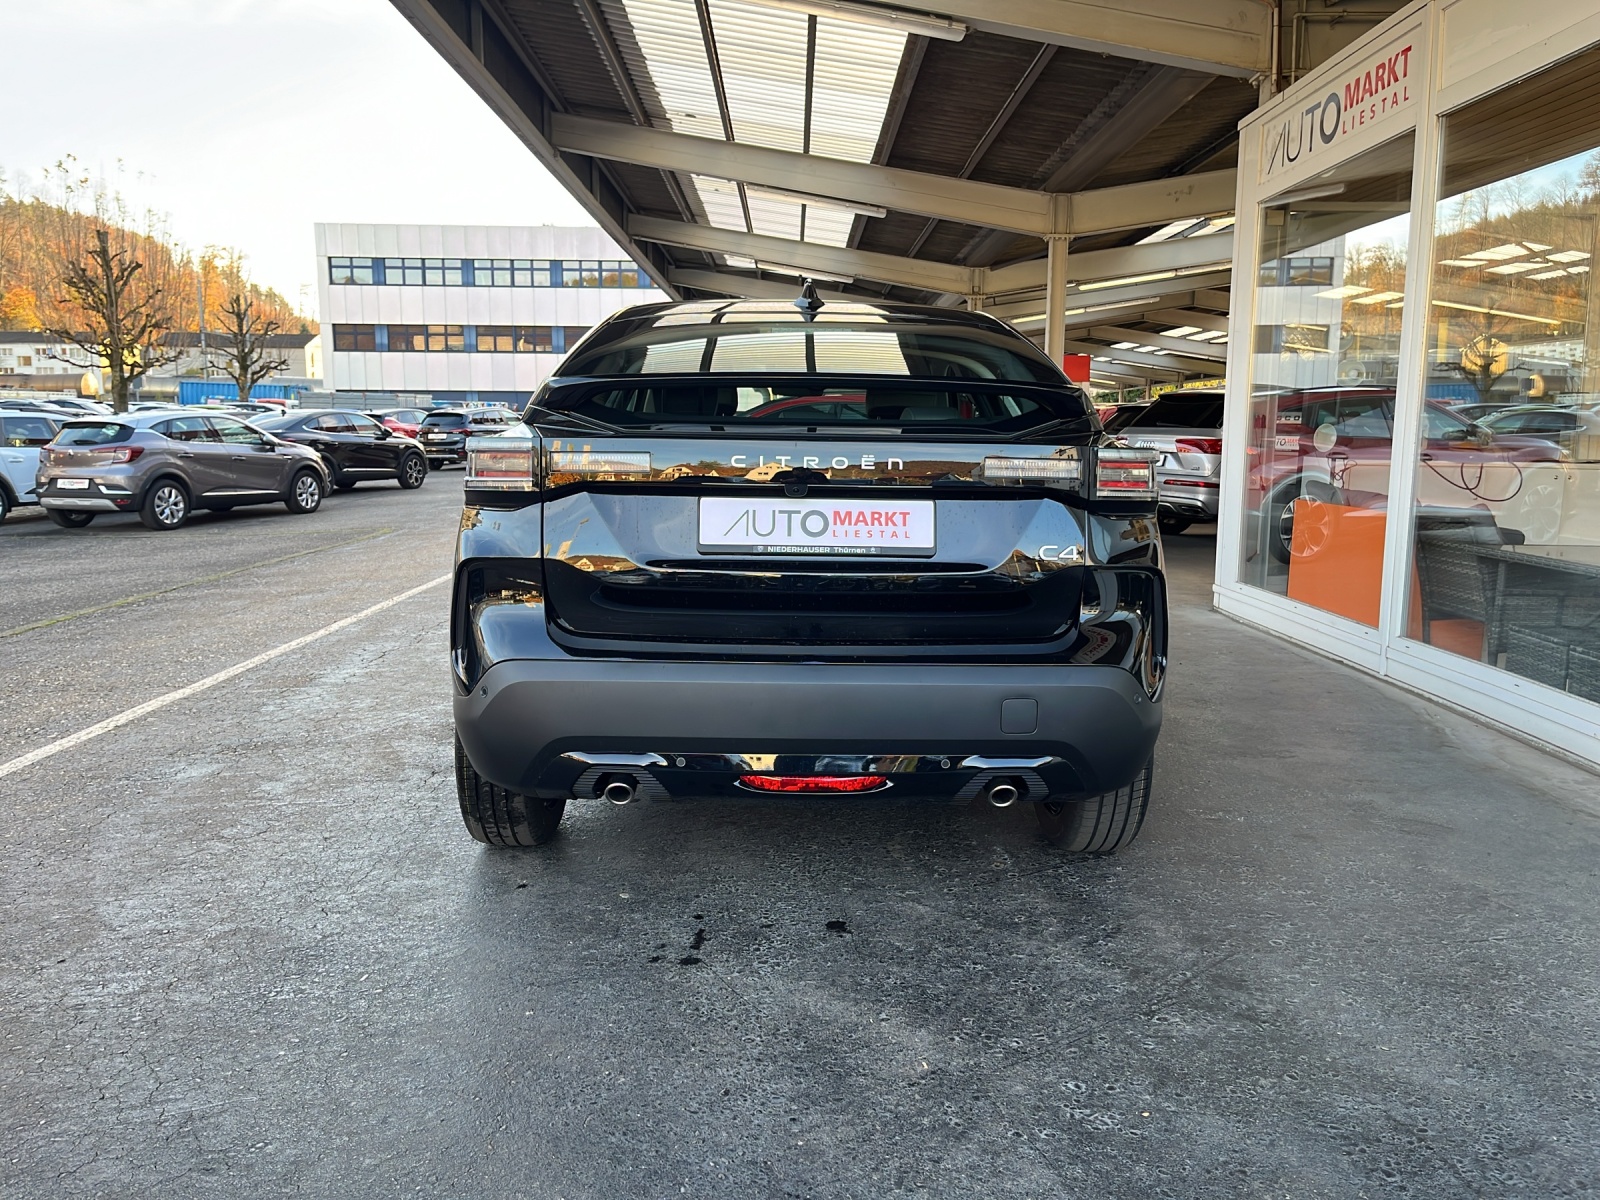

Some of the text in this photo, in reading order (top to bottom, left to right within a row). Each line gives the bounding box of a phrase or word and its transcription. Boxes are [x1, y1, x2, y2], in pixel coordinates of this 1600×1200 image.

[1267, 45, 1412, 175] AUTO MARKT
[1342, 86, 1409, 135] LIESTAL
[723, 509, 911, 538] AUTO MARKT
[832, 529, 911, 539] LIESTAL
[767, 545, 866, 554] NIEDERHAUSER Thürnen
[1038, 545, 1079, 561] C4
